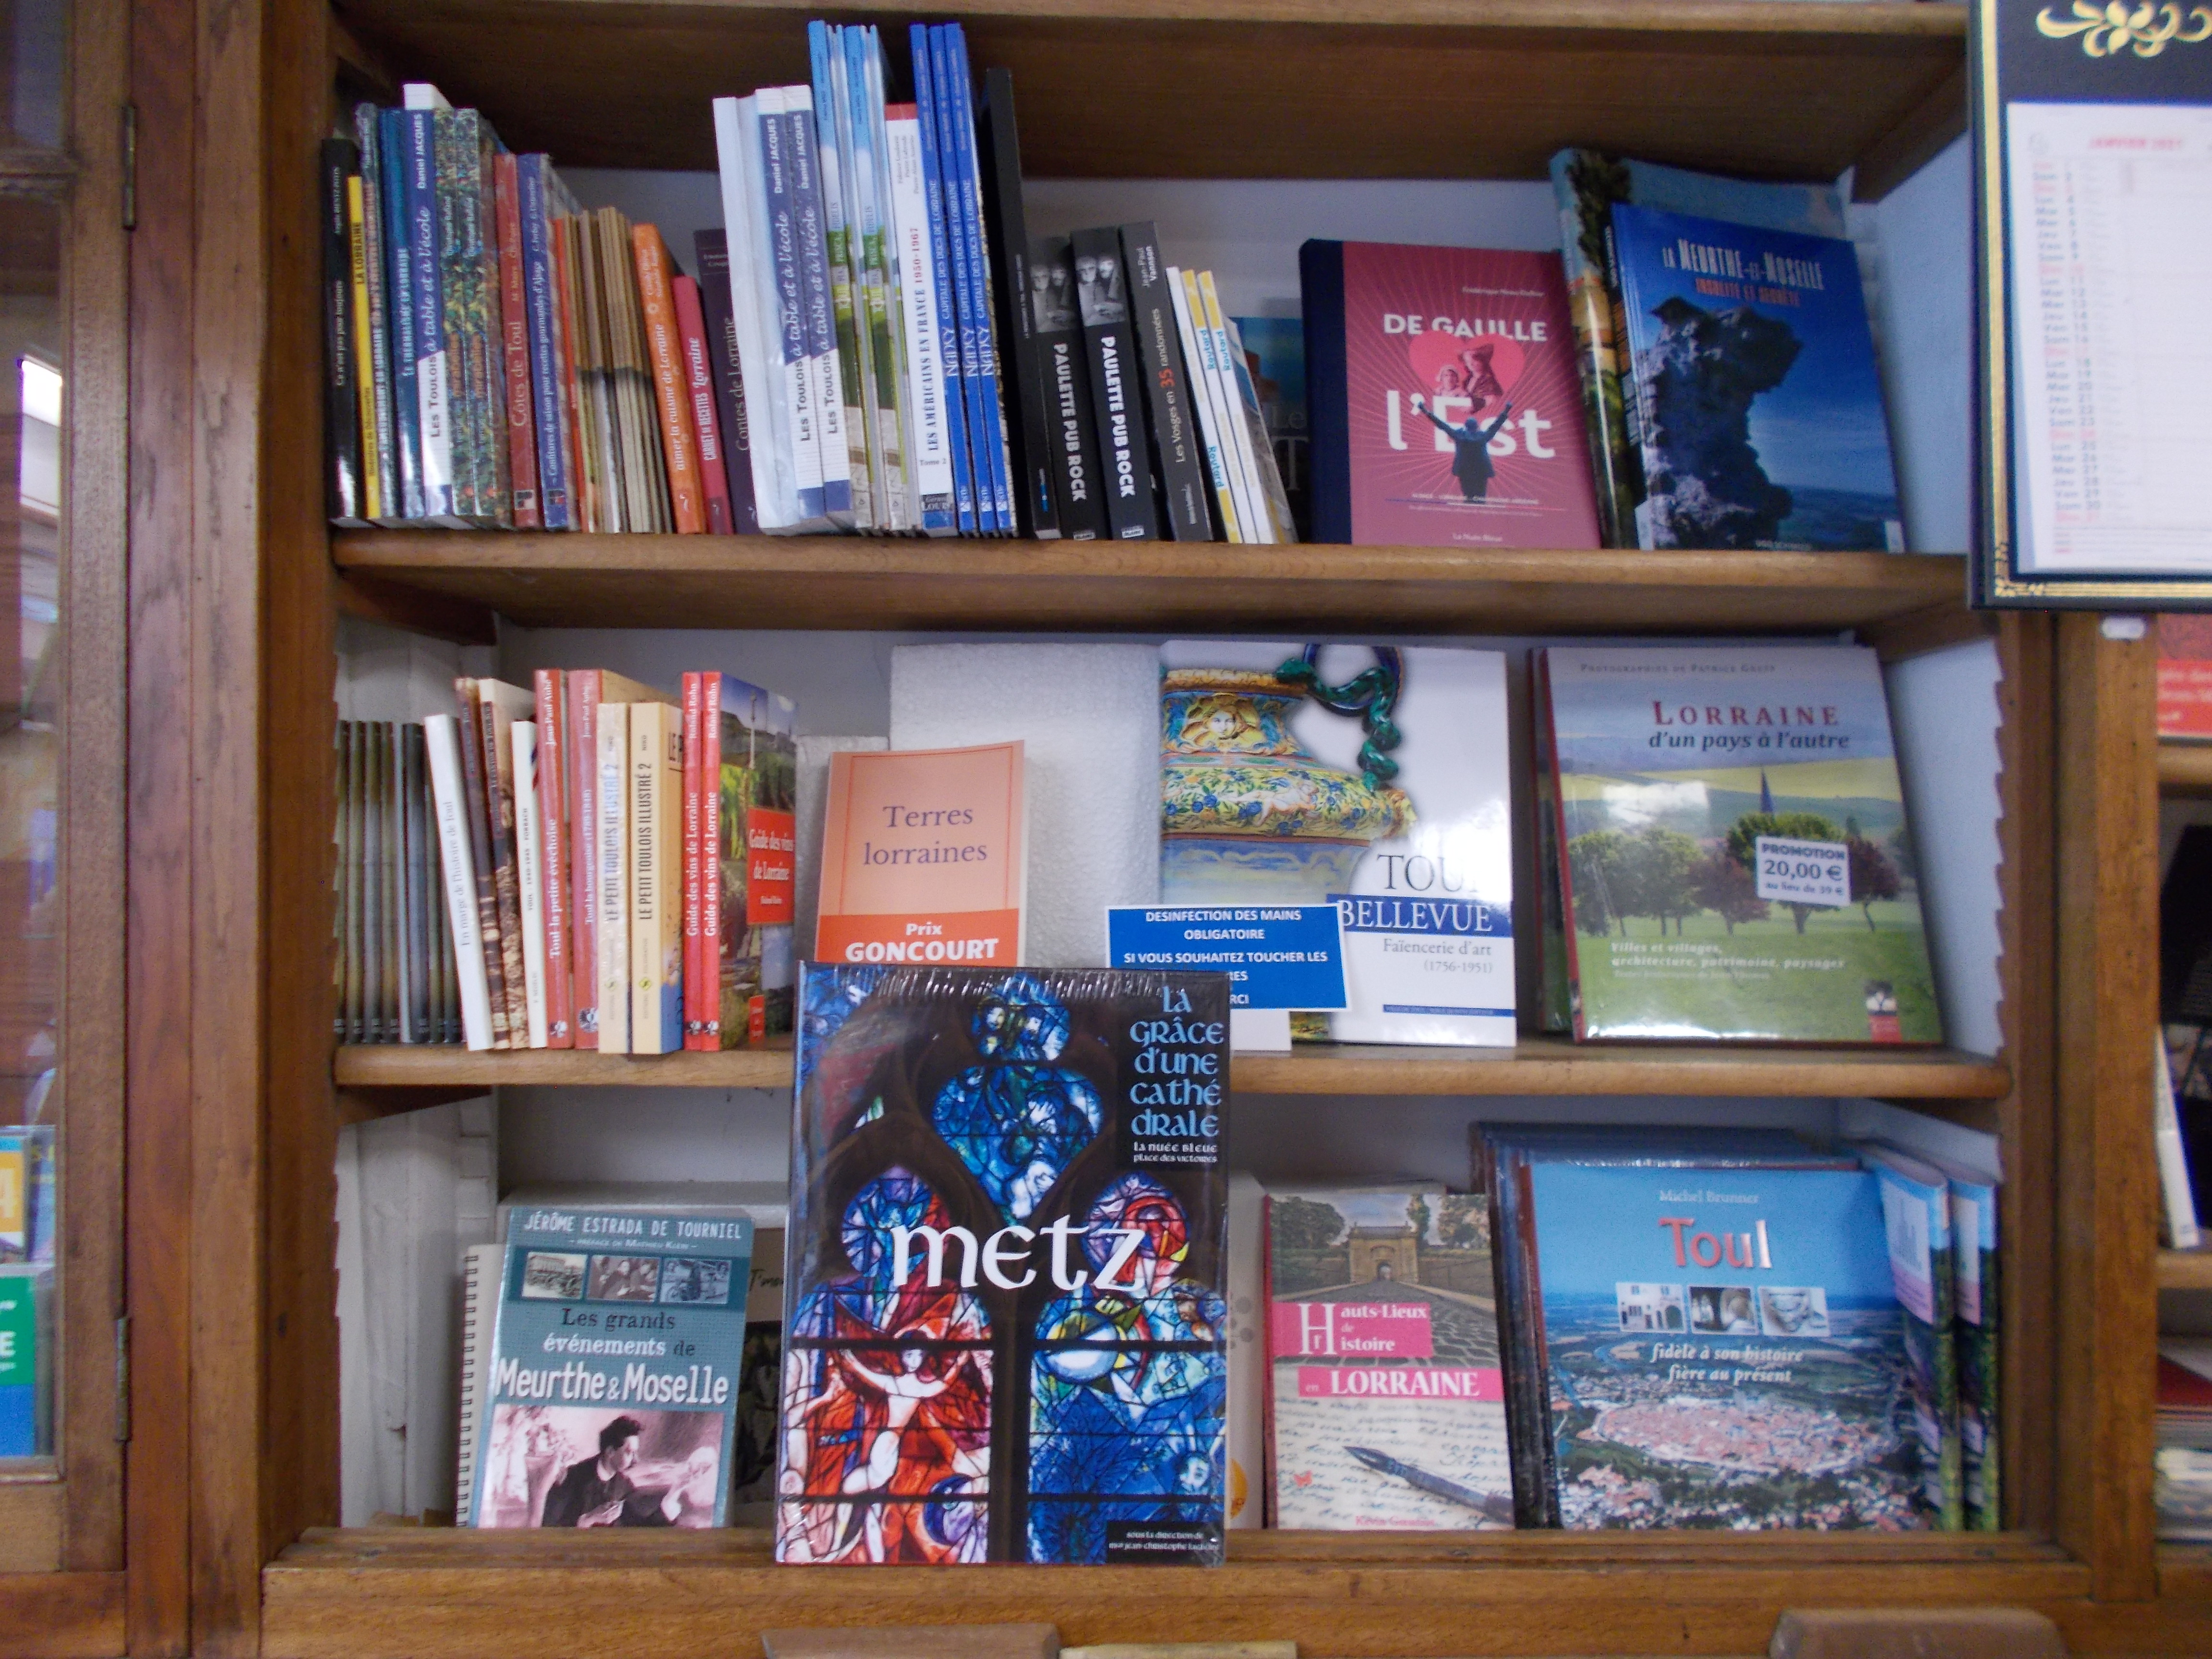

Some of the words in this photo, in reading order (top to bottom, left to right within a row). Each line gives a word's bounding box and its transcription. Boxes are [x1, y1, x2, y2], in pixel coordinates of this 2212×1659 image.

[413, 113, 424, 155] JACQUES
[414, 158, 427, 189] Daniel
[928, 179, 941, 221] LORRAINE
[415, 206, 431, 256] l'école
[933, 225, 943, 236] DE
[351, 222, 364, 270] LORRAINE
[910, 227, 923, 284] 1950-1967
[355, 273, 365, 285] LA
[416, 259, 432, 273] à
[937, 262, 947, 278] DES
[418, 276, 433, 292] et
[914, 289, 928, 333] FRANCE
[938, 281, 950, 320] CAPITALE
[421, 294, 435, 335] table
[533, 295, 548, 344] gourmandes
[1383, 313, 1423, 335] DE
[1431, 316, 1548, 342] GAULLE
[423, 340, 436, 351] à
[507, 321, 523, 354] Toul
[654, 324, 670, 368] Lorraine
[721, 317, 741, 375] Lorraine
[918, 339, 930, 352] EN
[1151, 308, 1170, 367] randonnées
[1199, 329, 1215, 370] Routard
[510, 360, 524, 377] de
[537, 345, 549, 375] recettes
[688, 338, 708, 389] Lorraine
[428, 357, 439, 409] TOULOIS
[541, 376, 554, 396] pour
[661, 371, 672, 384] de
[794, 361, 808, 413] TOULOIS
[1054, 343, 1077, 418] PAULETTE
[1101, 336, 1124, 412] PAULETTE
[1157, 368, 1175, 388] 35
[727, 381, 744, 397] de
[918, 357, 937, 428] AMÉRICAINS
[1165, 391, 1175, 405] en
[665, 386, 678, 423] cuisine
[695, 392, 711, 426] RECETTES
[430, 415, 440, 438] LES
[543, 423, 553, 433] de
[670, 425, 680, 436] la
[733, 402, 749, 451] Contes
[799, 418, 811, 442] LES
[1063, 419, 1081, 452] PUB
[1111, 413, 1129, 447] PUB
[1167, 406, 1183, 444] Vosges
[700, 434, 717, 461] CARNET
[926, 432, 939, 451] LES
[1173, 444, 1186, 463] Les
[543, 434, 557, 476] Confitures
[673, 439, 686, 471] aimer
[919, 458, 939, 466] Tome
[1208, 445, 1224, 488] Routard
[1067, 455, 1087, 502] ROCK
[1115, 448, 1136, 498] ROCK
[1652, 700, 1839, 726] LORRAINE
[1649, 732, 1695, 748] d'un
[1701, 735, 1752, 752] pays
[1757, 732, 1771, 748] à
[1777, 732, 1850, 748] l'autre
[602, 773, 618, 824] ILLUSTRÉ
[635, 773, 652, 824] ILLUSTRÉ
[685, 792, 698, 838] Lorraine
[703, 792, 717, 838] Lorraine
[882, 805, 973, 828] Terres
[446, 824, 455, 836] de
[749, 828, 768, 850] Guide
[769, 830, 781, 851] des
[447, 839, 463, 882] l'histoire
[603, 828, 618, 873] TOULOIS
[637, 827, 652, 873] TOULOIS
[686, 841, 698, 854] de
[704, 841, 717, 854] de
[864, 841, 987, 865] lorraines
[583, 843, 595, 891] bourgeoise
[686, 857, 698, 879] vins
[704, 857, 717, 879] vins
[753, 860, 762, 880] de
[762, 860, 789, 880] Lorraine
[1377, 854, 1479, 893] TOU
[1765, 859, 1821, 880] 20,00
[1826, 865, 1843, 881] €
[454, 885, 464, 895] de
[548, 878, 563, 912] petite
[584, 893, 593, 902] la
[604, 877, 618, 905] PETIT
[638, 877, 652, 904] PETIT
[686, 882, 698, 901] des
[704, 882, 717, 901] des
[457, 899, 468, 928] marge
[548, 915, 560, 927] la
[584, 903, 594, 925] Toul
[604, 909, 619, 921] LE
[638, 908, 652, 920] LE
[686, 904, 699, 936] Guide
[704, 904, 717, 936] Guide
[1146, 910, 1232, 922] DESINFECTION
[1235, 911, 1258, 921] DES
[1261, 910, 1301, 921] MAINS
[1340, 899, 1493, 932] BELLEVUE
[905, 921, 942, 936] Prix
[1184, 929, 1265, 940] OBLIGATOIRE
[548, 931, 562, 959] Toul
[845, 938, 999, 962] GONCOURT
[1124, 952, 1135, 963] SI
[1138, 952, 1173, 963] VOUS
[1175, 951, 1245, 963] SOUHAITEZ
[1247, 951, 1304, 962] TOUCHER
[1307, 951, 1328, 962] LES
[1382, 938, 1454, 955] Faïencerie
[1458, 940, 1492, 956] d'art
[1611, 942, 1647, 953] Villes
[1650, 943, 1663, 952] et
[1424, 960, 1493, 974] (1756-1951)
[1230, 994, 1250, 1005] RCI
[1659, 1190, 1704, 1203] Michel
[524, 1210, 575, 1233] JÉRÔME
[582, 1217, 643, 1236] ESTRADA
[650, 1219, 668, 1238] DE
[677, 1220, 742, 1239] TOURNIEL
[1658, 1217, 1773, 1269] Toul
[561, 1308, 598, 1327] Les
[605, 1311, 675, 1331] grands
[1340, 1322, 1355, 1333] de
[542, 1333, 667, 1355] événements
[673, 1340, 696, 1357] de
[1649, 1343, 1697, 1363] fidèle
[1700, 1346, 1710, 1360] à
[1714, 1350, 1742, 1360] son
[1743, 1346, 1804, 1362] histoire
[1330, 1370, 1480, 1396] LORRAINE
[1667, 1364, 1707, 1384] fière
[1709, 1369, 1729, 1381] au
[1733, 1368, 1792, 1387] présent
